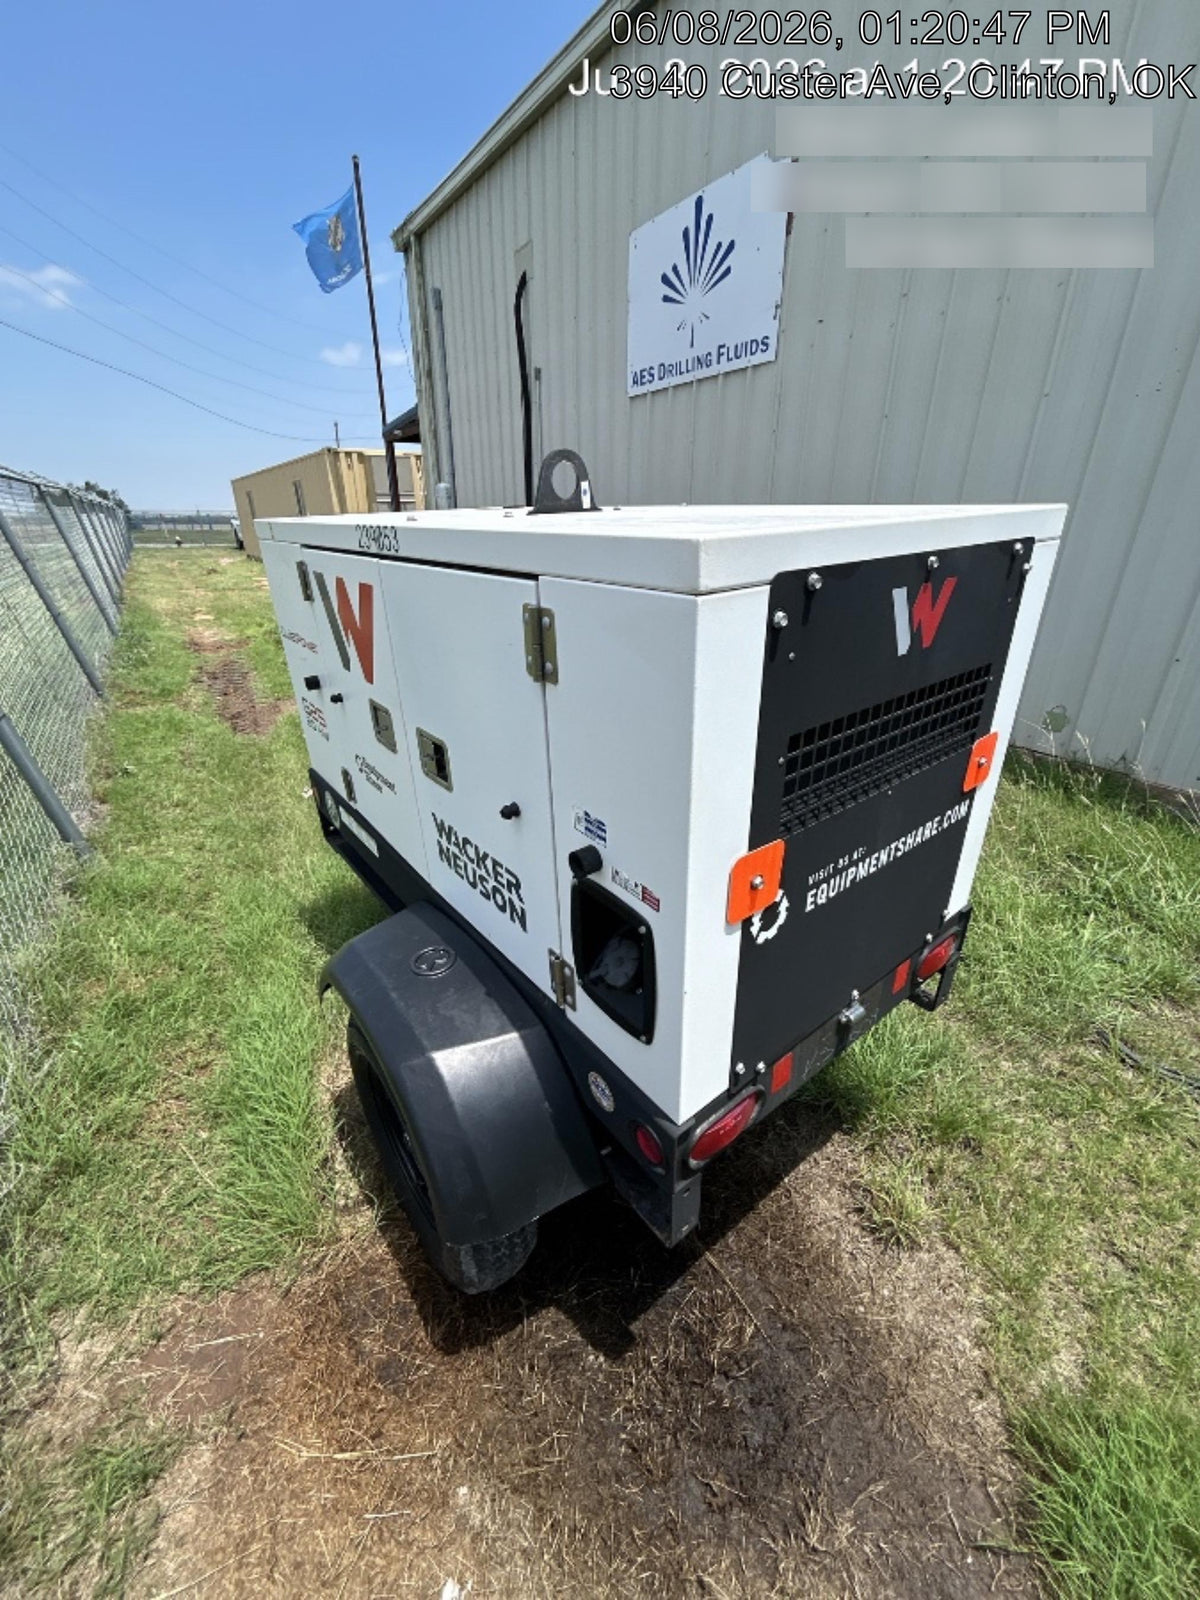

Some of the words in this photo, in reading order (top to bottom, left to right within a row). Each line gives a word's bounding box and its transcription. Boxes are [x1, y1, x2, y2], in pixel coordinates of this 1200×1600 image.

[631, 366, 655, 388] AES
[657, 352, 712, 382] DRILLING
[716, 335, 770, 365] FLUIDS
[431, 812, 525, 906] WACKER
[436, 838, 529, 934] NEUSON
[805, 799, 970, 913] EQUIPMENTSHARE.COM
[808, 863, 834, 885] VISIT
